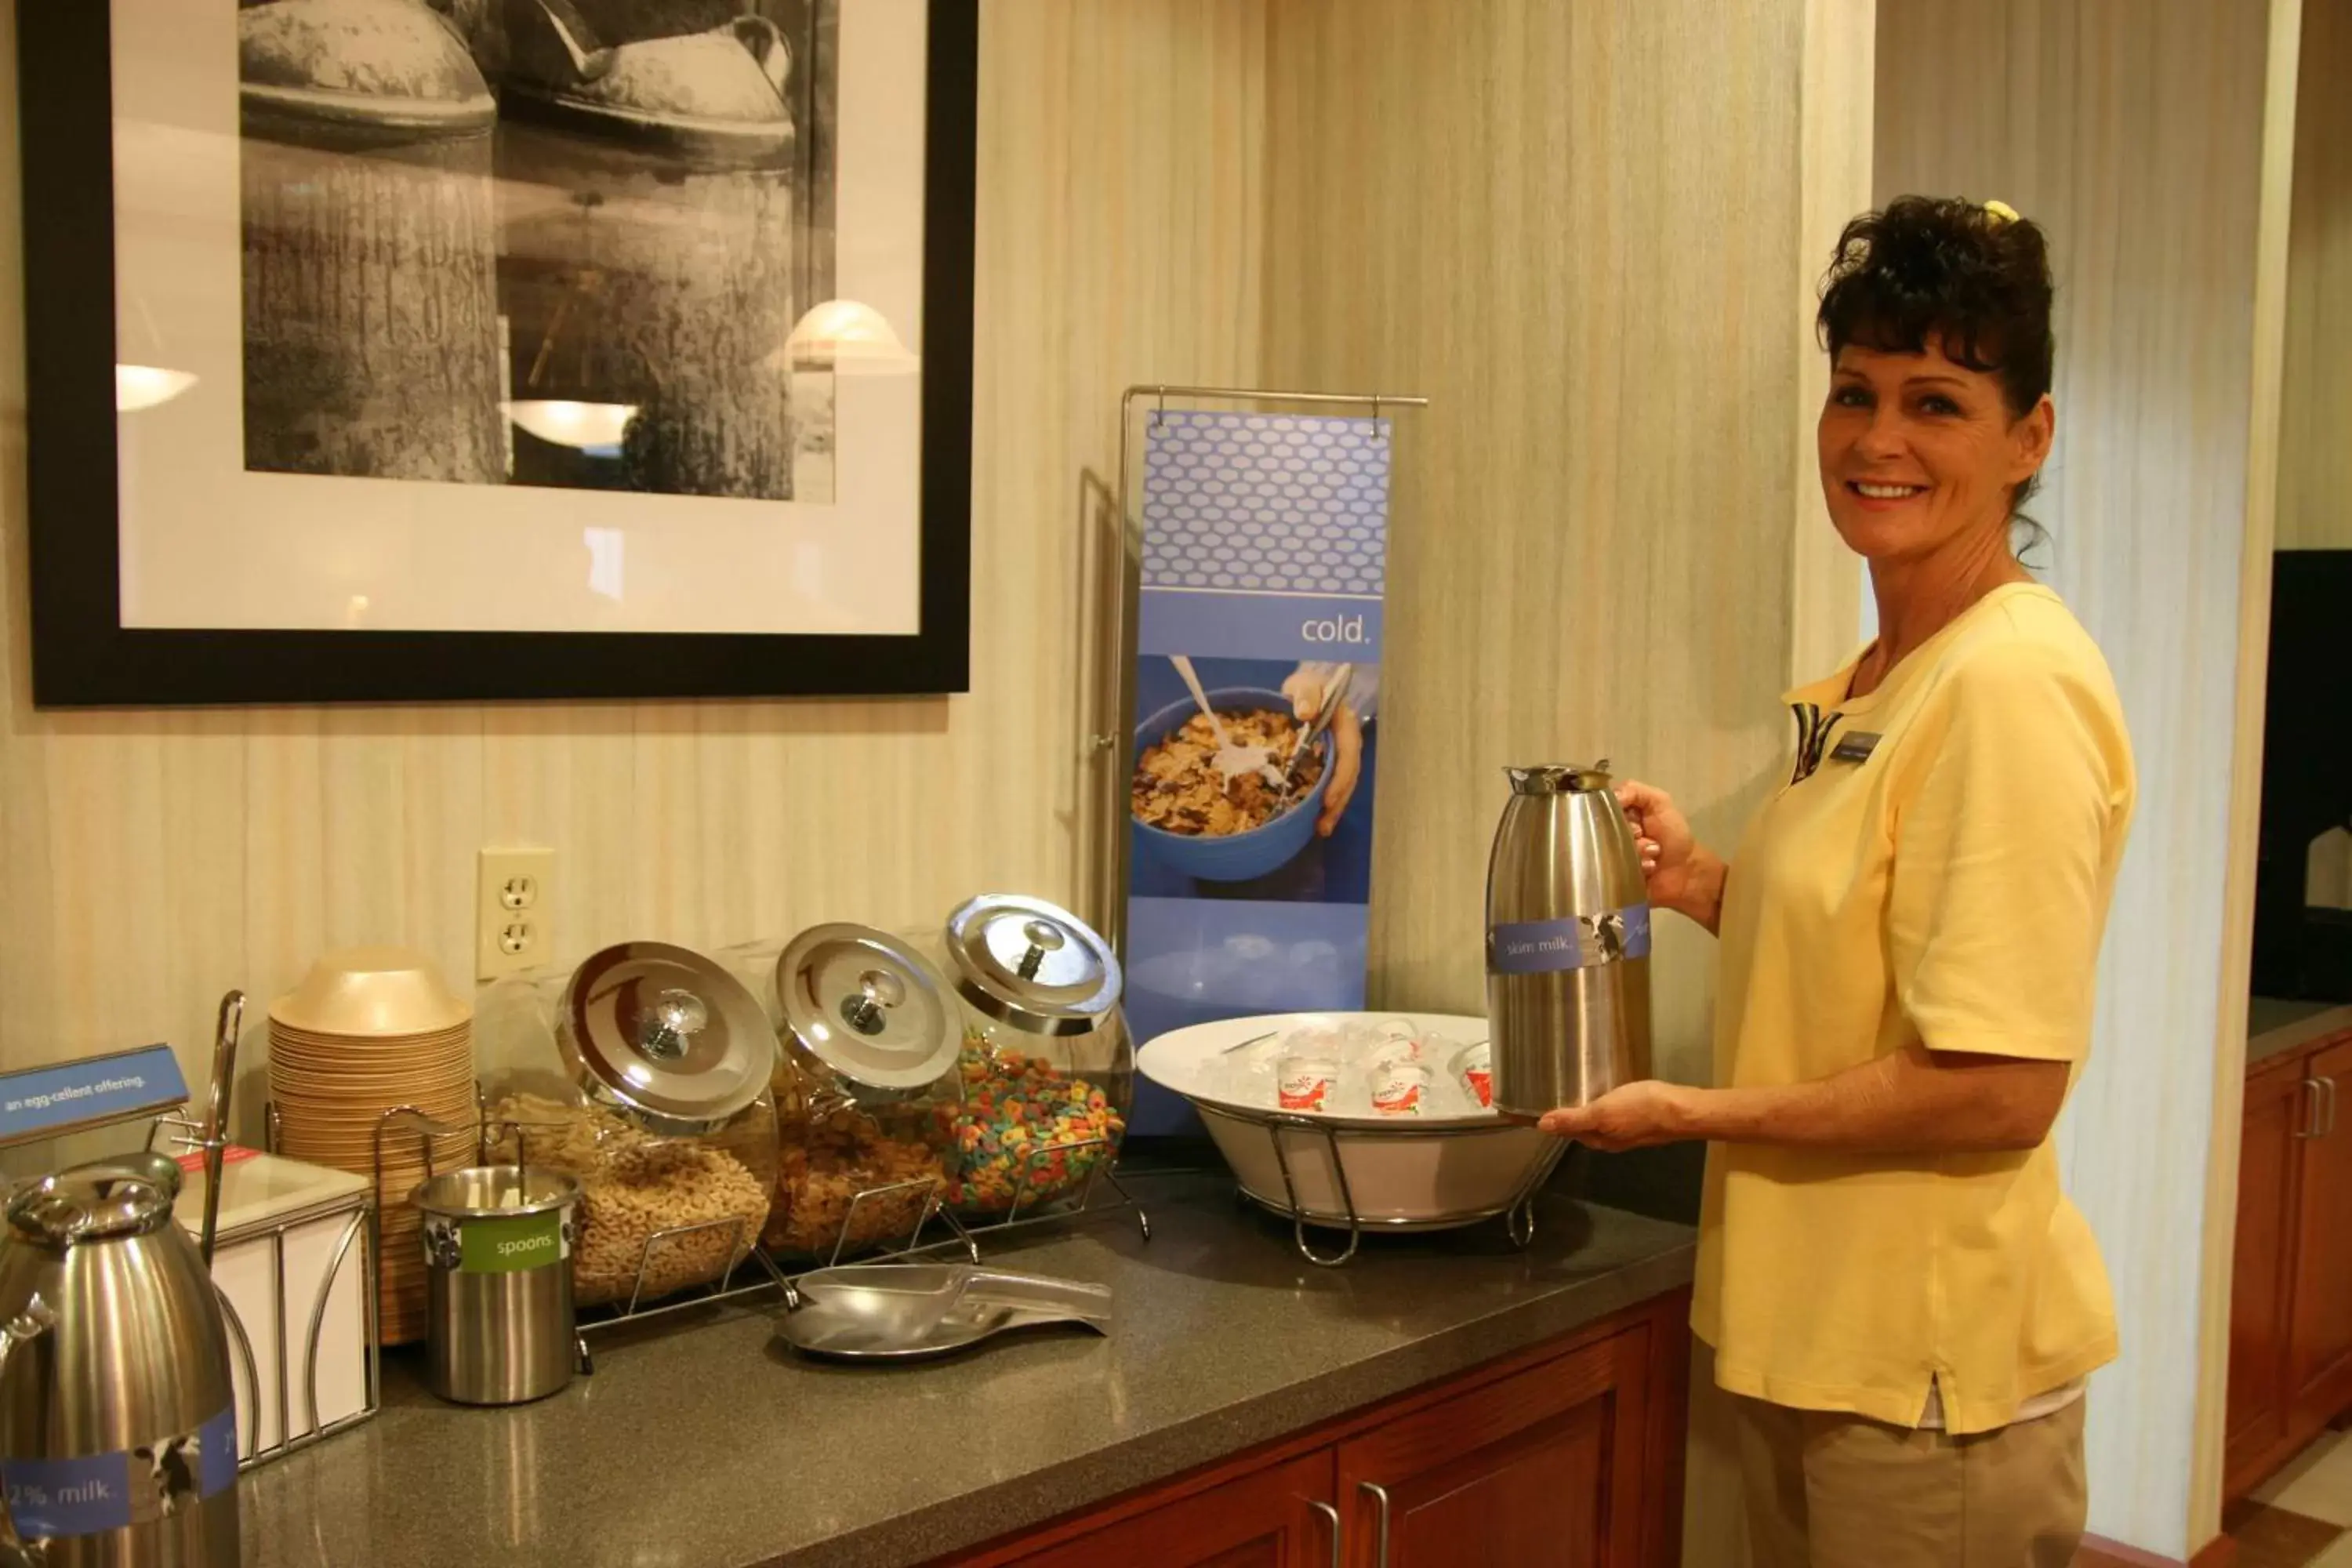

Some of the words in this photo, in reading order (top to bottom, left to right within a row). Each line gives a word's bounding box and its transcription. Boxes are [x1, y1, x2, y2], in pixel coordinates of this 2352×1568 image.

[1301, 614, 1371, 644] cold.
[1506, 939, 1535, 956] skim
[5, 1100, 23, 1112] an
[24, 1084, 93, 1109] egg-cellent
[94, 1075, 146, 1093] offering.
[9, 1483, 48, 1507] 2%
